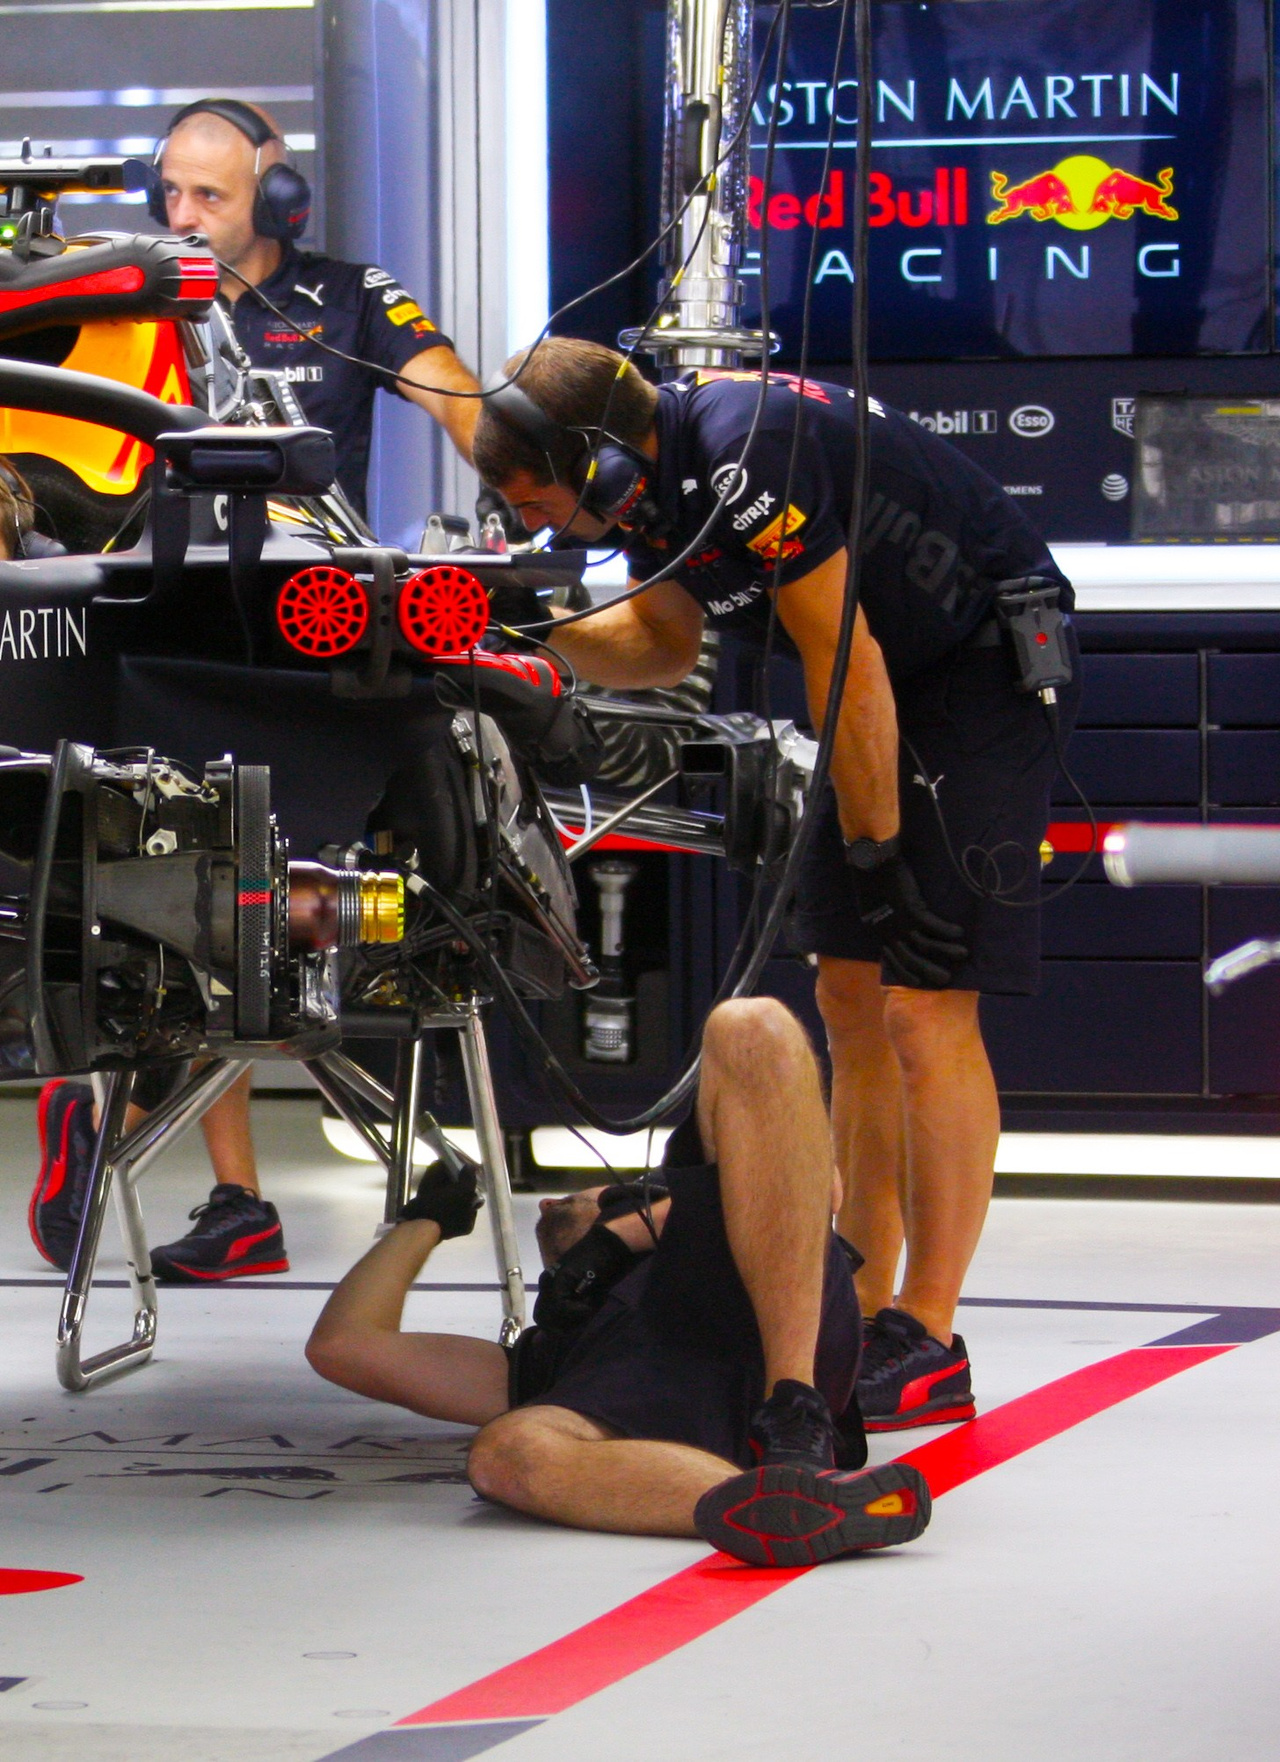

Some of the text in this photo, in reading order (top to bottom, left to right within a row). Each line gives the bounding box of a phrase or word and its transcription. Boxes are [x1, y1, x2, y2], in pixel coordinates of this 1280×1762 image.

[750, 72, 1180, 127] STON MARTIN
[284, 366, 305, 382] bil
[1016, 413, 1048, 428] Esso
